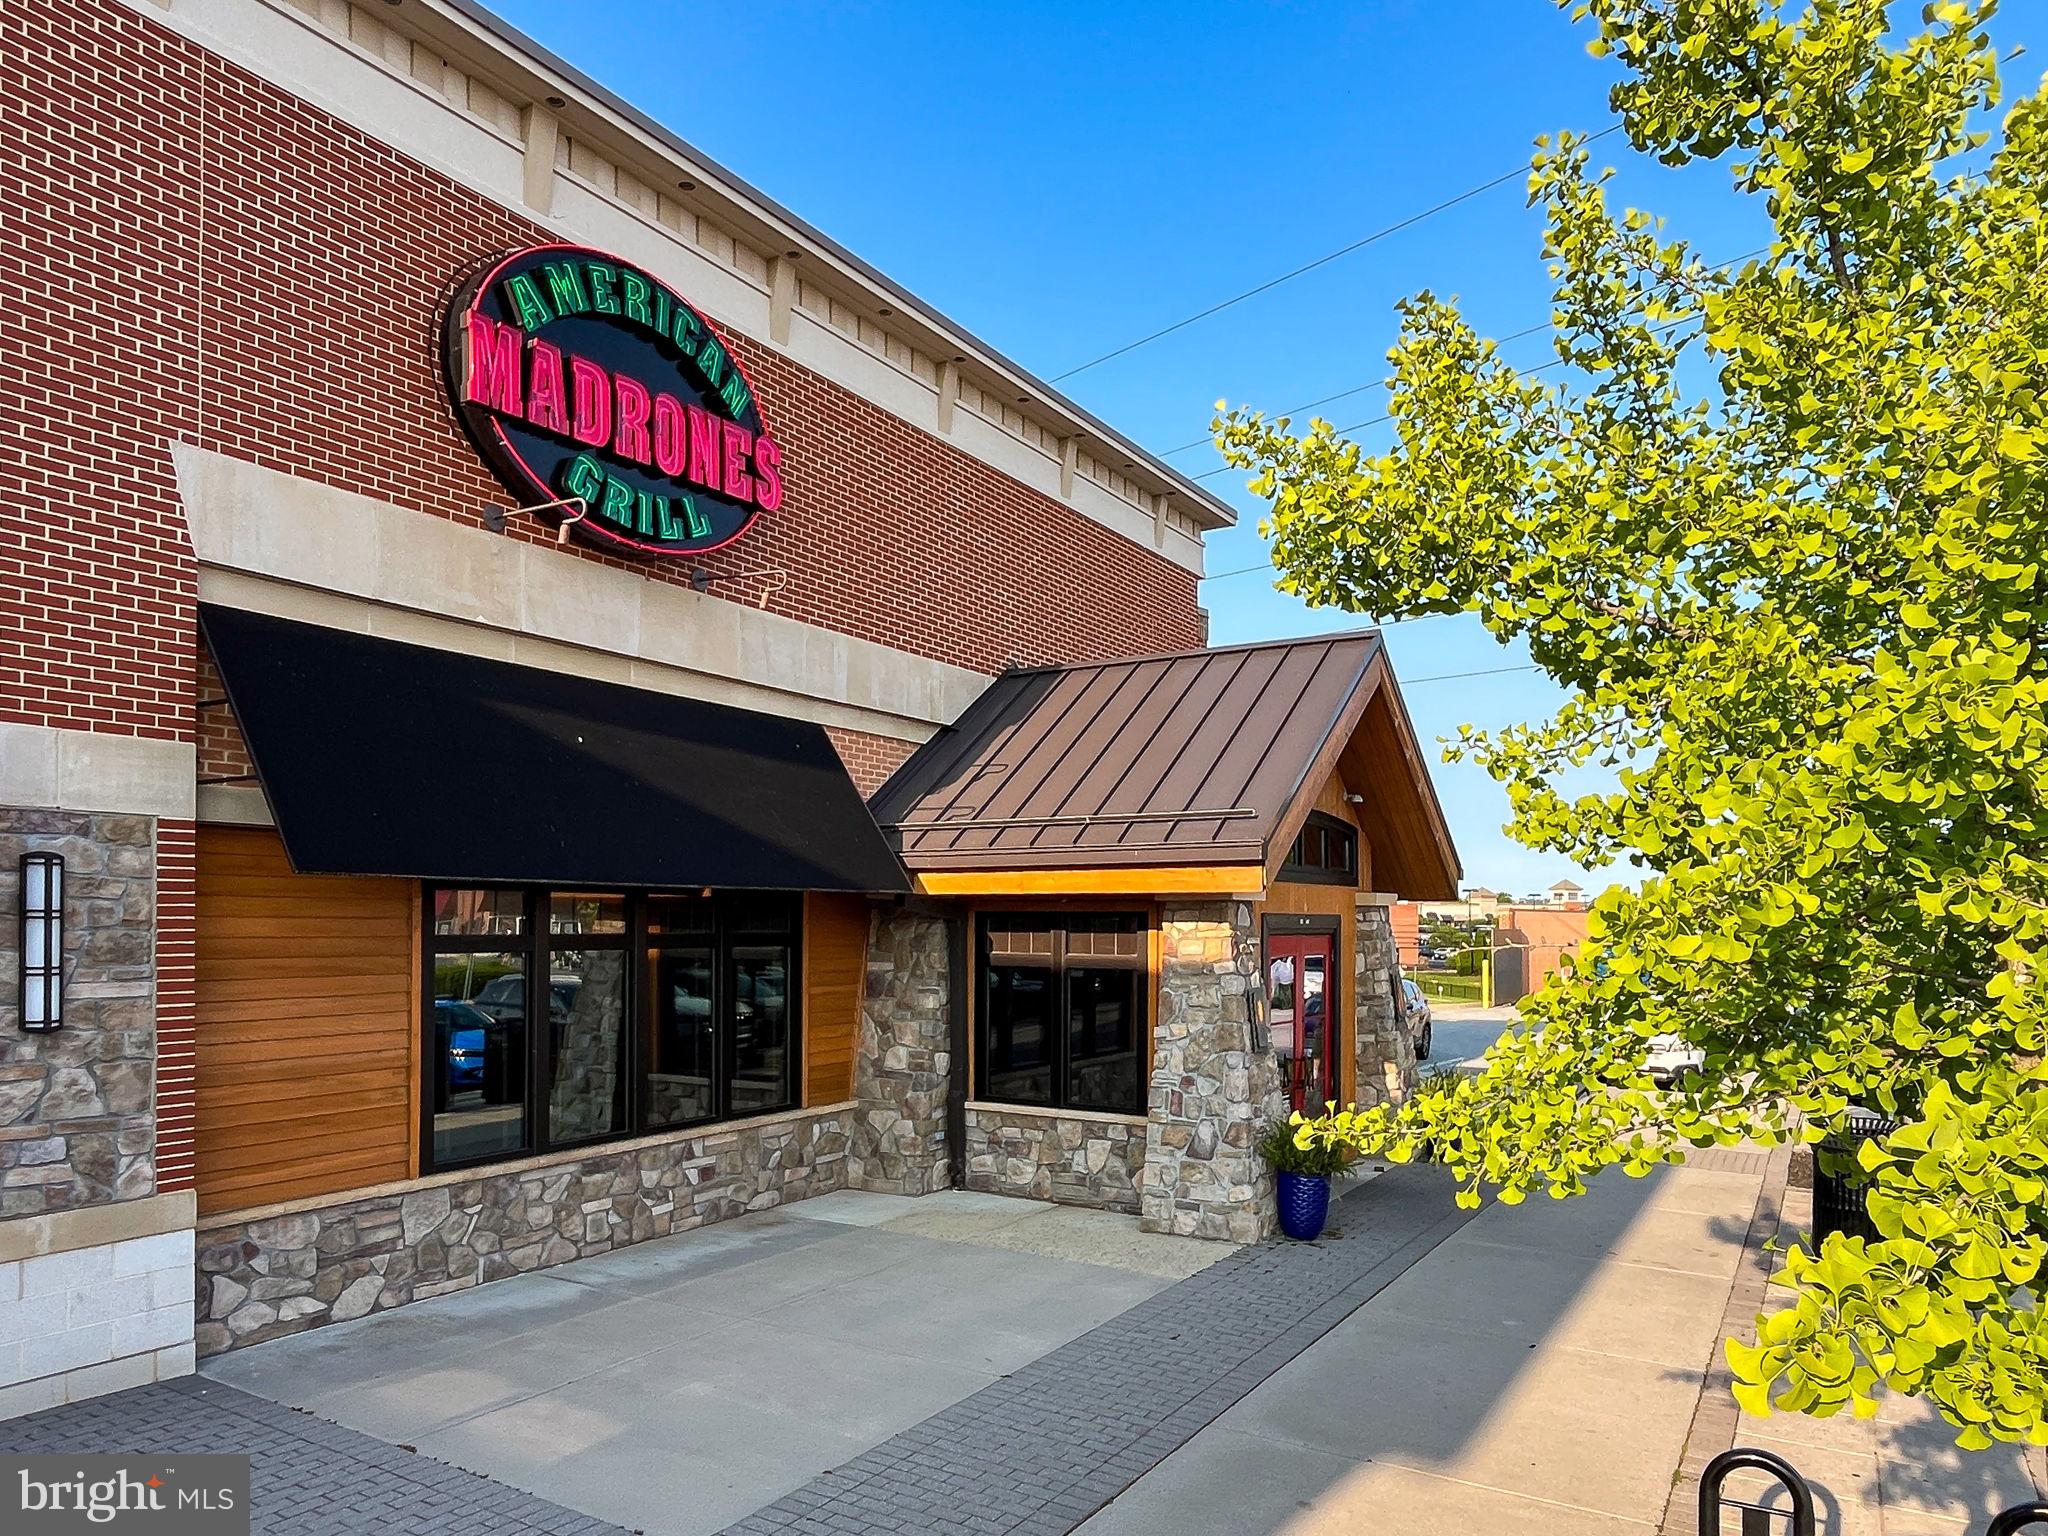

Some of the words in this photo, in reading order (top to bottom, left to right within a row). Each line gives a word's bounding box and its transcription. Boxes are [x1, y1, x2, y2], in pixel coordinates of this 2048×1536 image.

[463, 307, 782, 512] MADRONES
[505, 259, 749, 420] AMERICAN
[562, 452, 713, 540] GRILL
